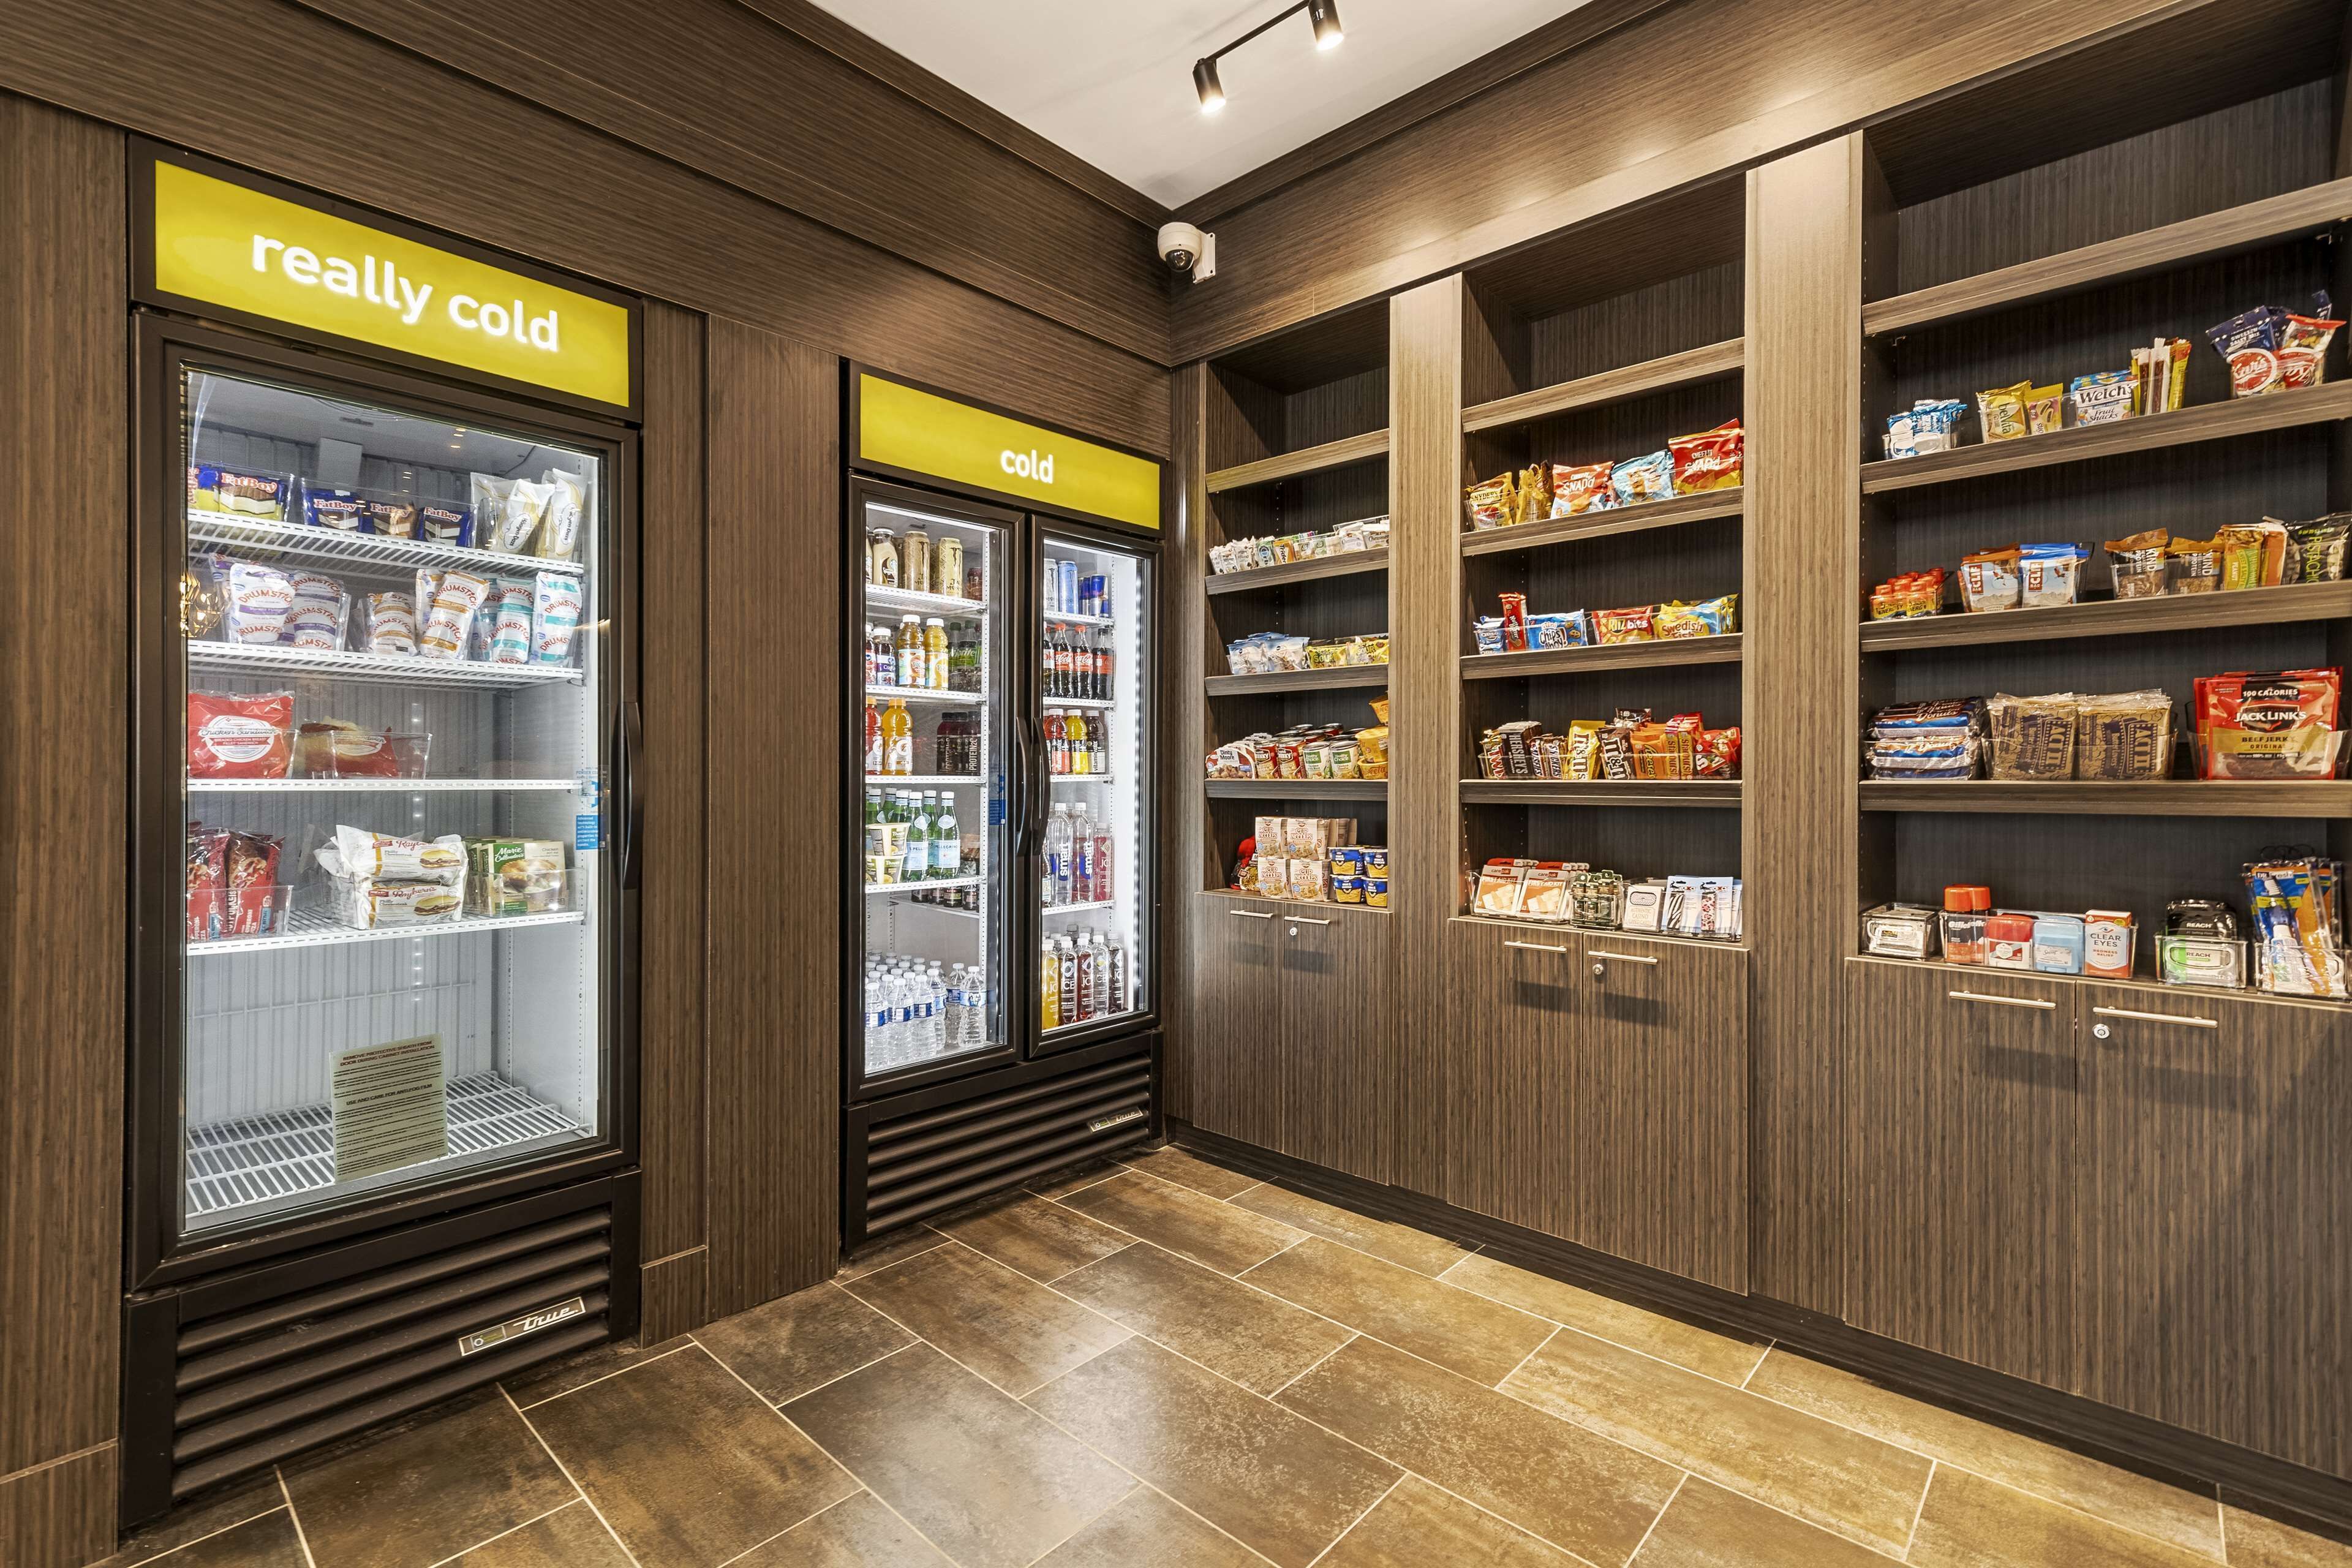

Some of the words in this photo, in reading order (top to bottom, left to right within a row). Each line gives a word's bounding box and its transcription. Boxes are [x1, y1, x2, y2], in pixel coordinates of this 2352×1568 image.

[251, 234, 433, 325] really
[448, 293, 560, 353] cold
[2079, 382, 2133, 404] Welch's
[1998, 402, 2011, 434] belVita
[1000, 449, 1054, 484] cold
[221, 472, 277, 493] FatBoy
[314, 499, 358, 511] FatBoy
[424, 507, 462, 522] FatBoy
[2146, 548, 2157, 571] KIND
[2306, 537, 2323, 583] PISTACHIO
[1970, 565, 1981, 587] CLIF
[2030, 562, 2043, 584] CLIF
[545, 600, 581, 614] DRUMSTIC
[1608, 618, 1627, 630] RITZ
[1627, 618, 1649, 629] bits
[1662, 619, 1704, 636] Swedish
[2258, 688, 2298, 696] CALORIES
[2234, 712, 2267, 722] JACK
[2048, 725, 2065, 750] ACT
[2111, 733, 2120, 749] Butter
[2135, 728, 2152, 753] ACT
[1509, 732, 1528, 774] HERSHEY'S
[1548, 744, 1562, 778] SNCKERS
[2046, 752, 2062, 766] II
[2134, 755, 2150, 769] II
[497, 846, 522, 855] Marie
[2090, 933, 2122, 941] CLEAR
[342, 1052, 366, 1061] REMOVE
[366, 1047, 396, 1057] PROTECTIVE
[400, 1044, 435, 1055] INSTALLATION
[513, 1307, 579, 1331] true
